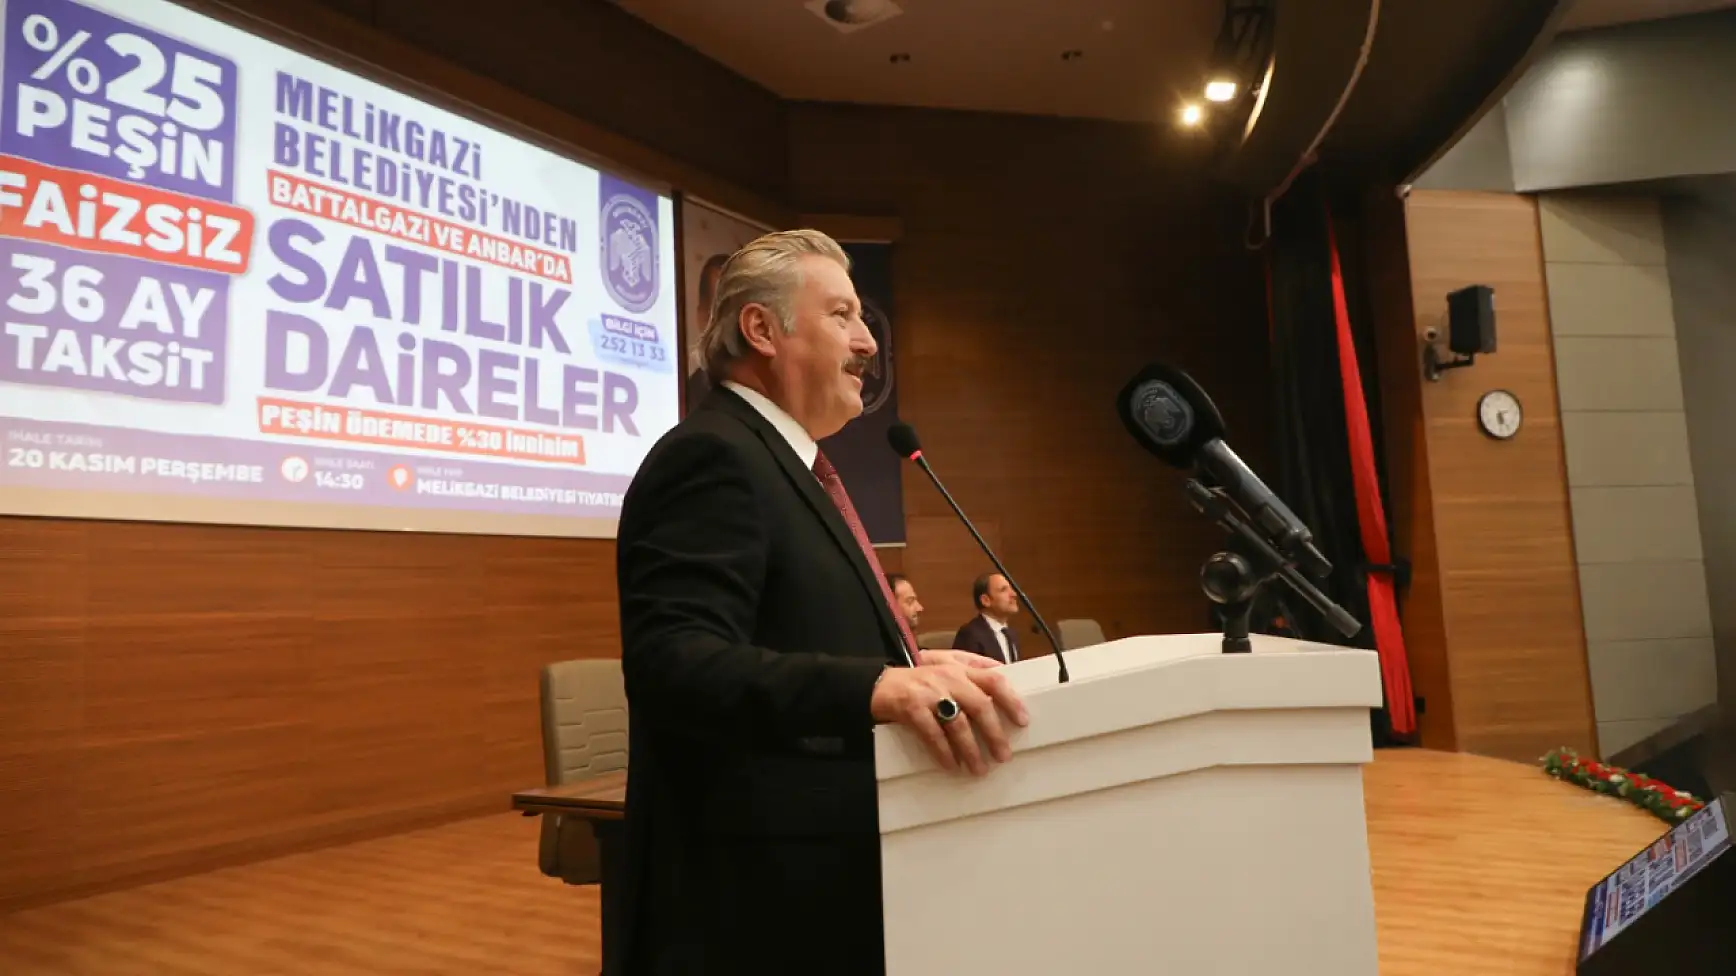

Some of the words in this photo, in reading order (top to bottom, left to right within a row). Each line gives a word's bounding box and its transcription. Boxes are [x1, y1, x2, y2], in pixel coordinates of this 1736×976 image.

[22, 14, 224, 131] %25
[433, 221, 465, 251] VE
[6, 253, 104, 323] 36
[119, 276, 216, 339] AY
[267, 218, 573, 355] SATILIK
[600, 333, 627, 355] 252
[650, 345, 666, 362] 33
[456, 426, 502, 451] %30
[8, 447, 44, 469] 20
[48, 450, 136, 474] KASIM
[140, 457, 264, 484] PERŞEMBE
[313, 470, 364, 490] 14:30
